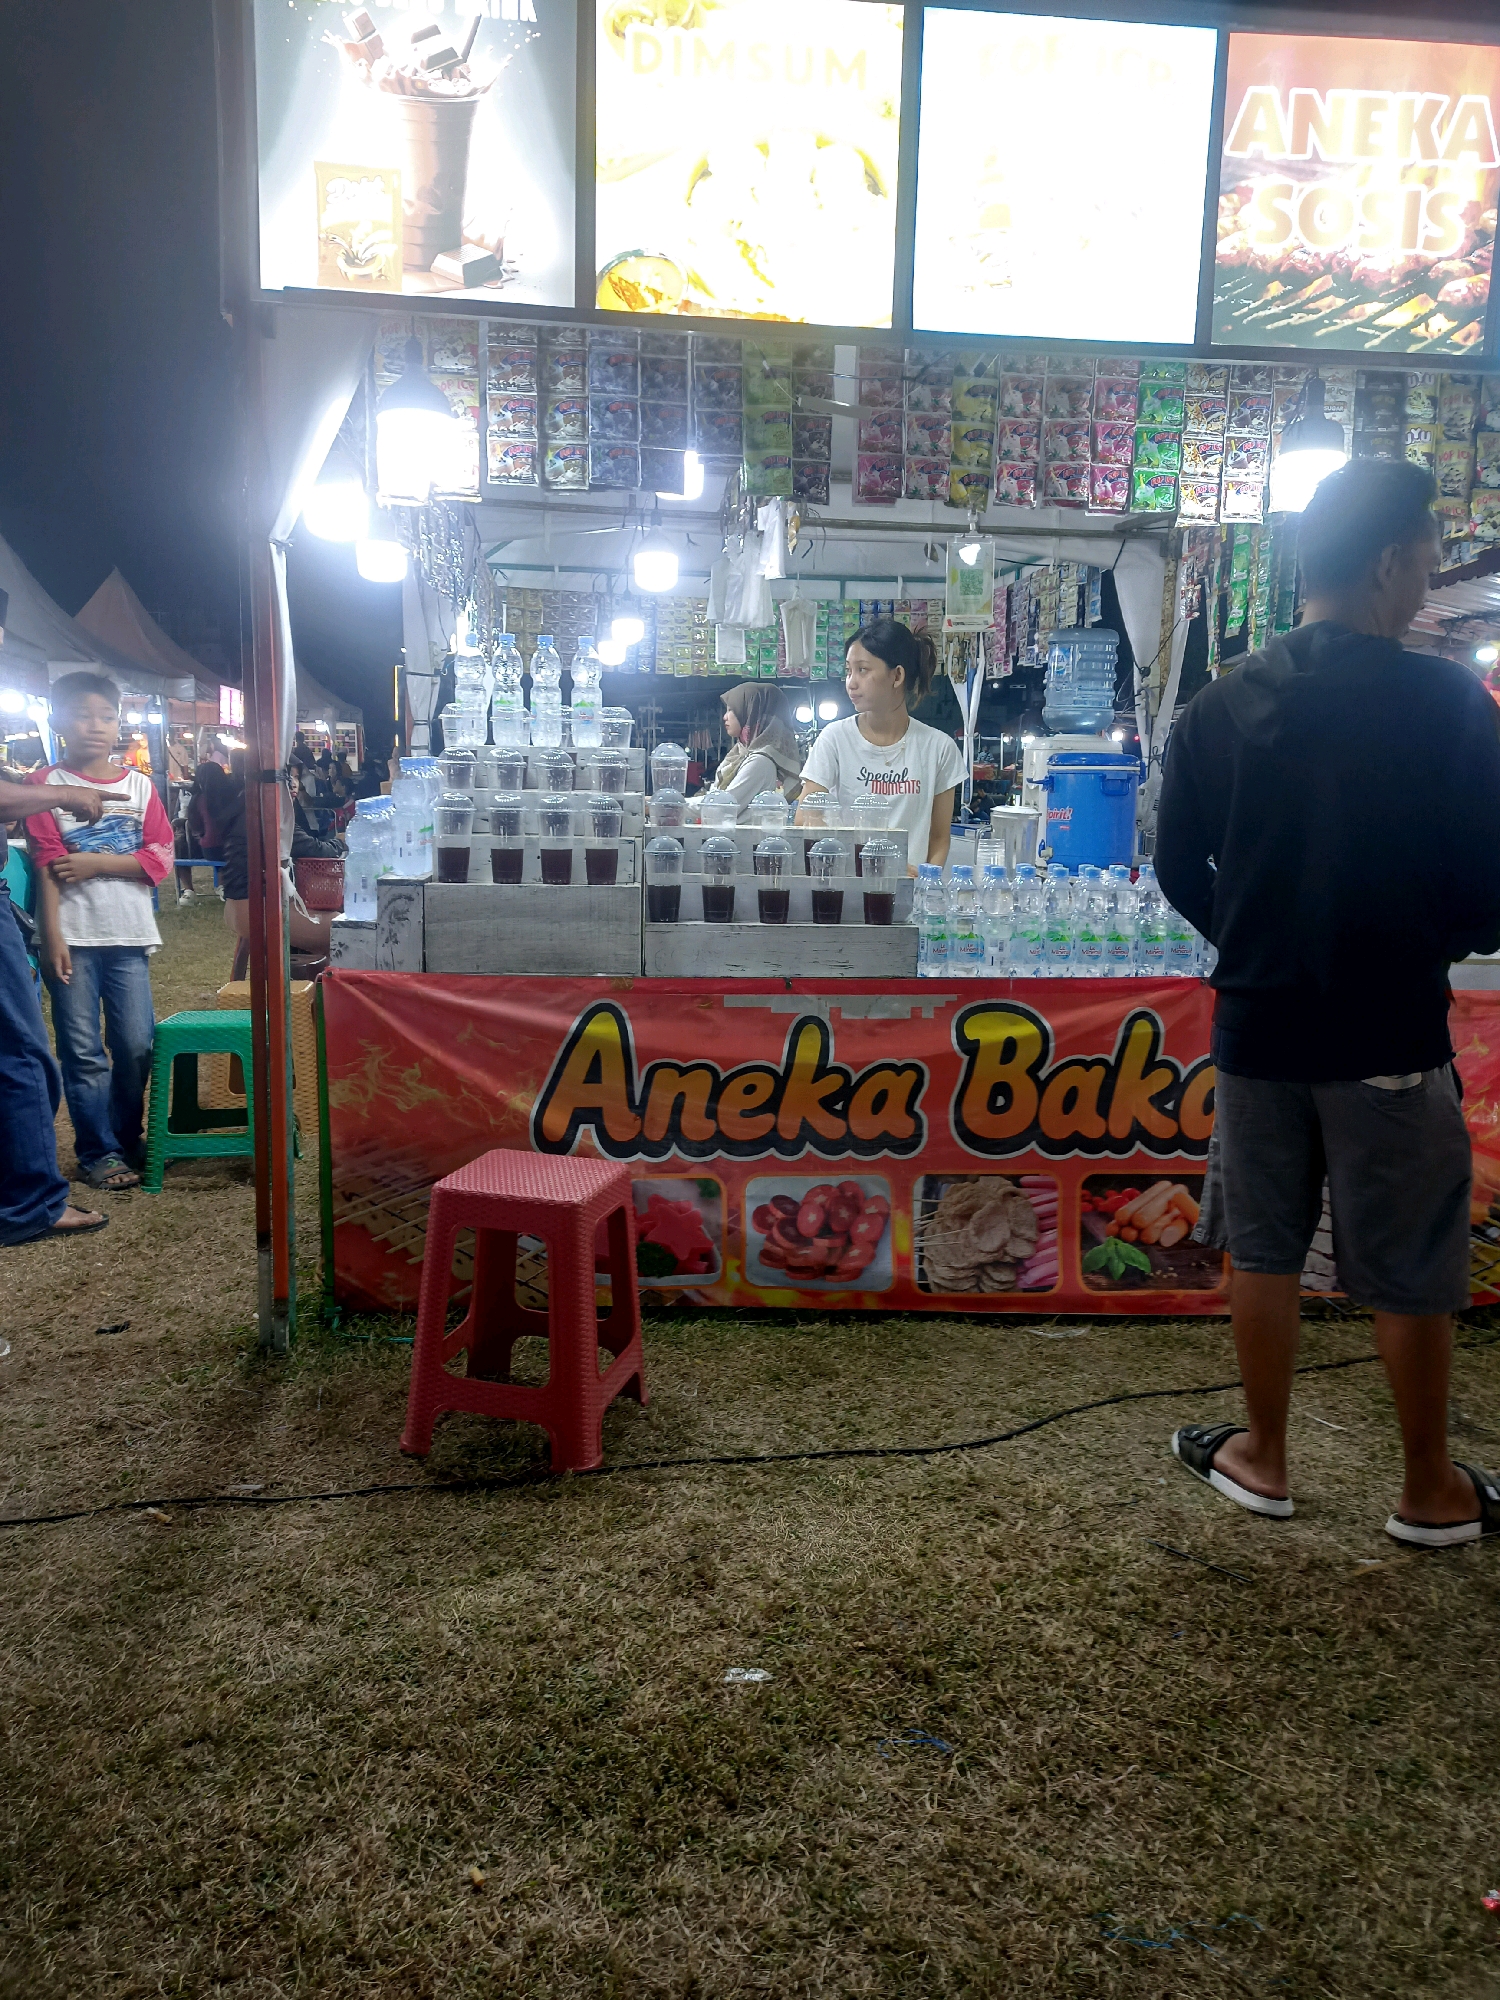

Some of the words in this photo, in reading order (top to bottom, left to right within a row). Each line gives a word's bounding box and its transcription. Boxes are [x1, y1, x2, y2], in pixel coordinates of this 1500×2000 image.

[631, 30, 867, 91] DIMSUM
[1224, 86, 1500, 168] ANEKA
[1250, 178, 1465, 257] SOSIS
[857, 766, 909, 787] Special
[533, 1000, 928, 1160] Aneka
